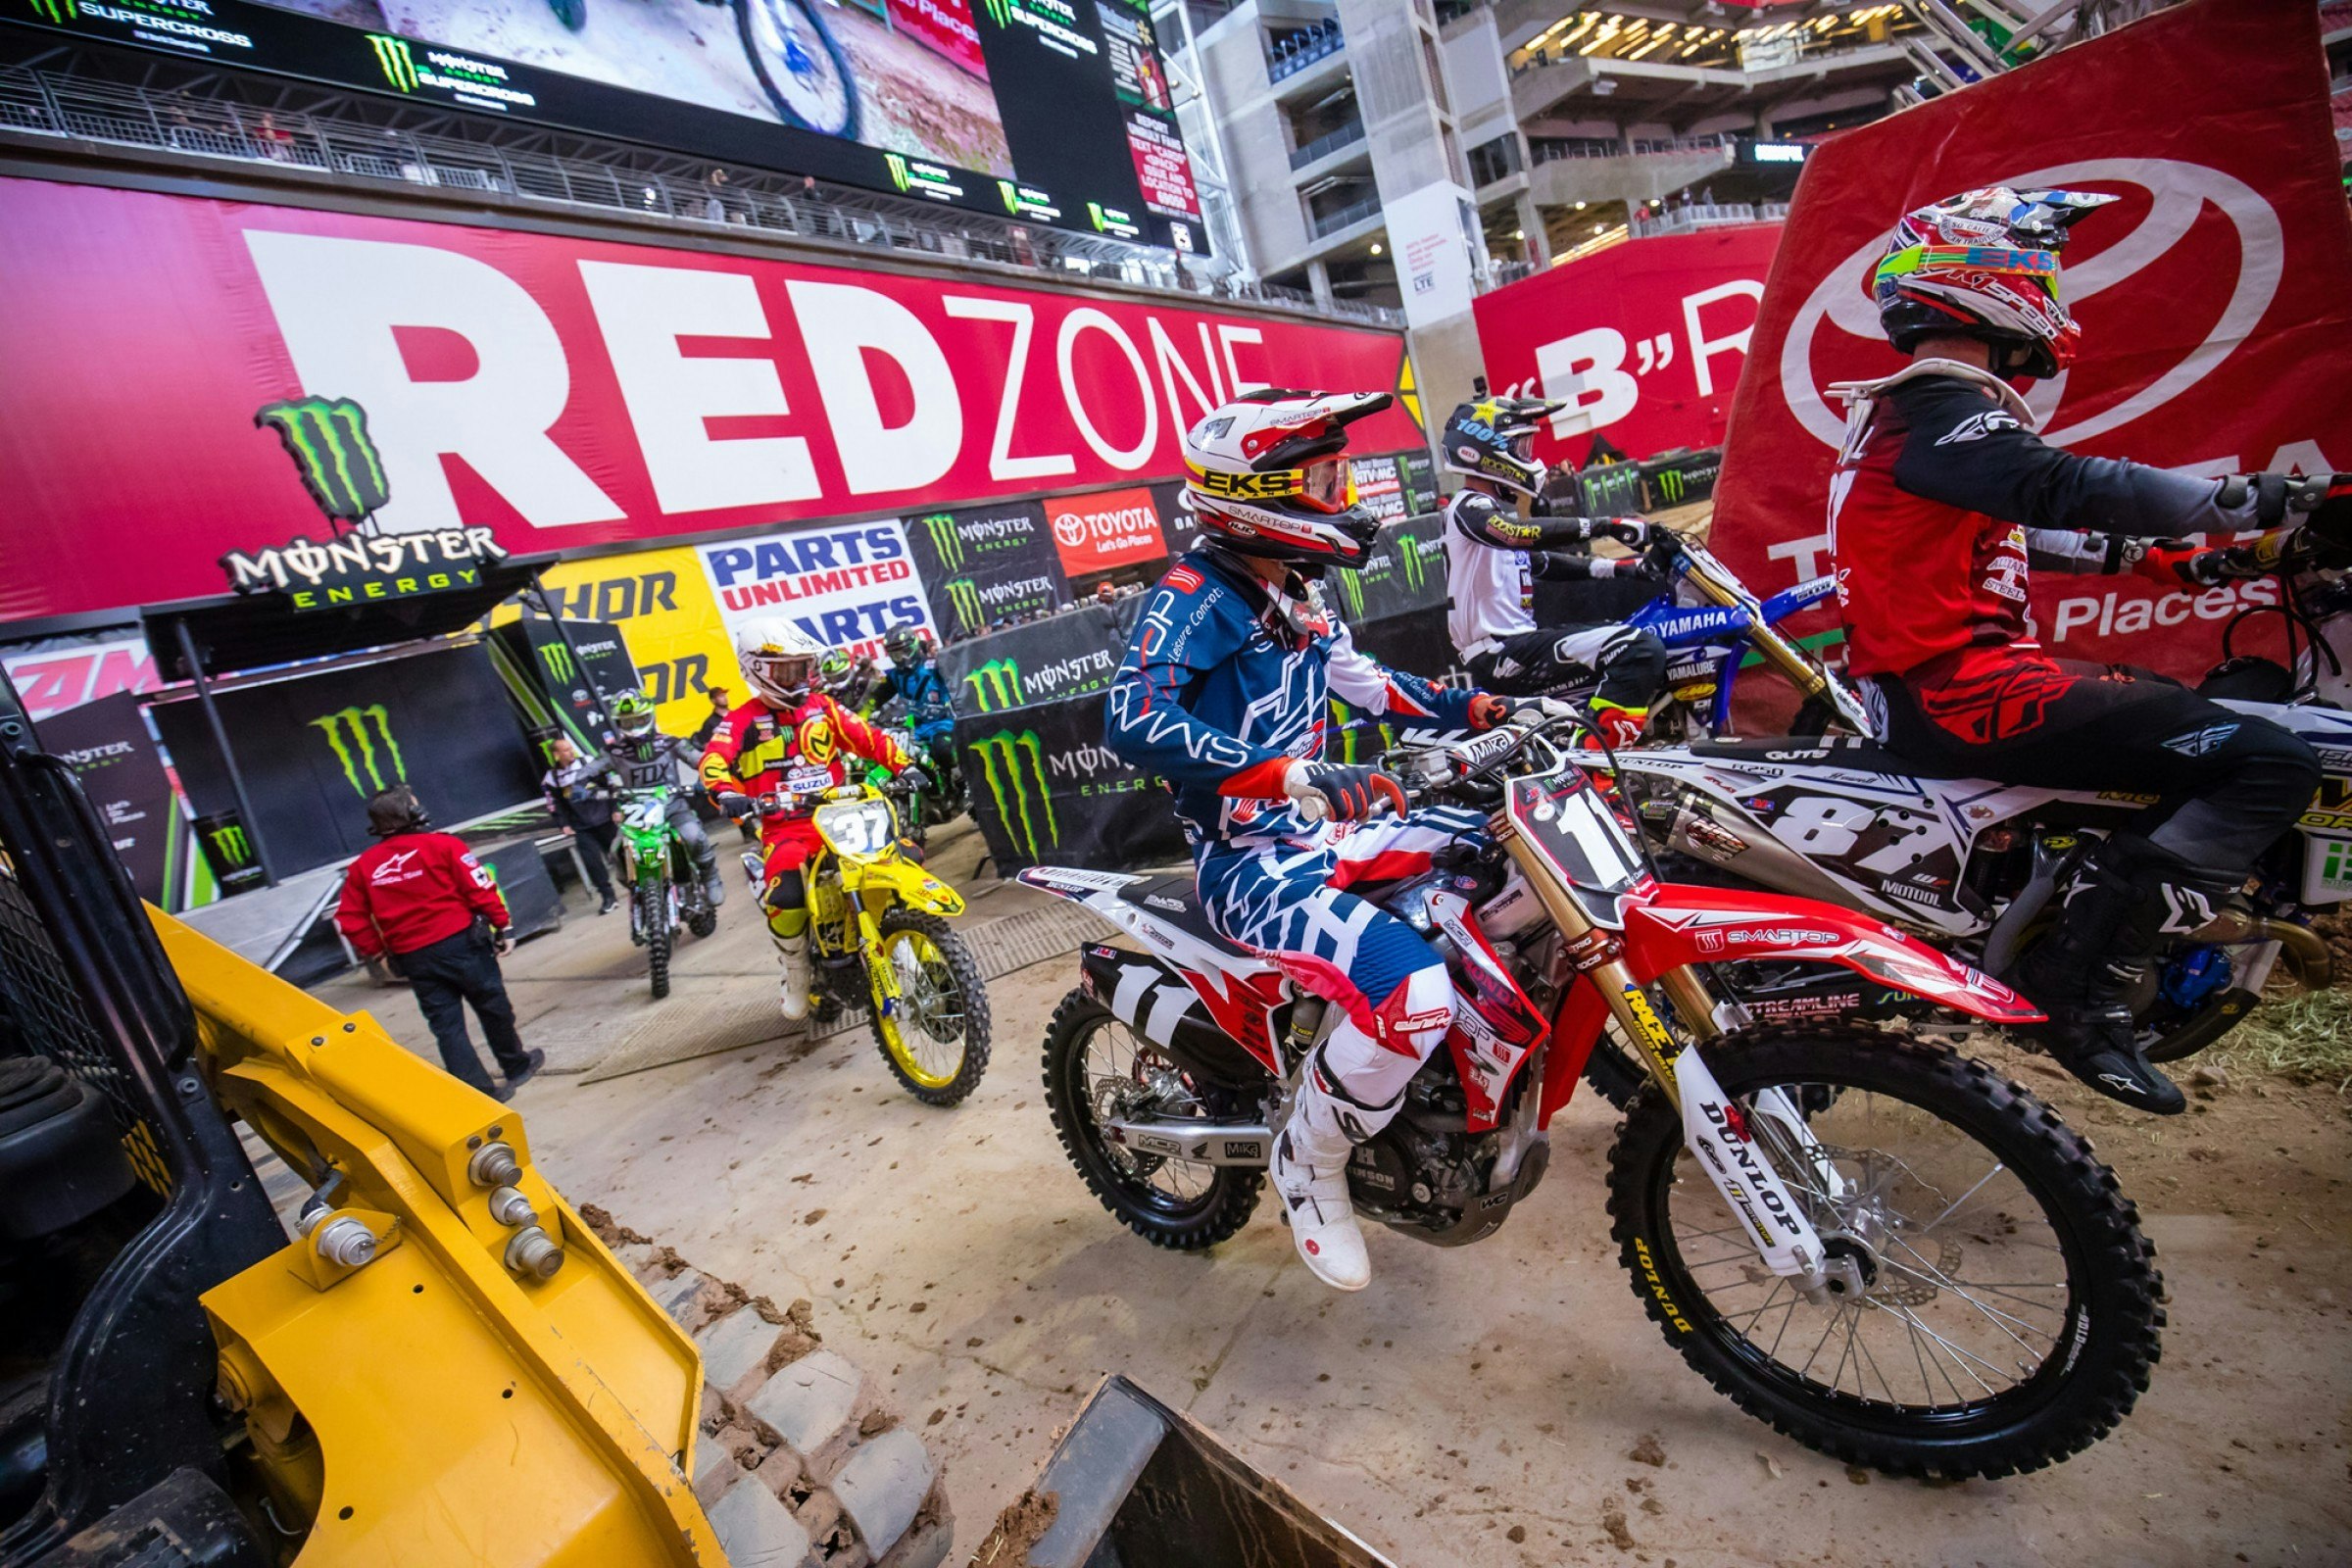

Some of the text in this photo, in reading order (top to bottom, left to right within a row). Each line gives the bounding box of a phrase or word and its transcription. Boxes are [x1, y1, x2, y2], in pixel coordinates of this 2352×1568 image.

[78, 1, 254, 48] SUPERCROSS
[1970, 248, 2056, 272] EKS
[1413, 275, 1435, 292] LTE
[1681, 278, 1767, 398] R
[1270, 410, 1324, 426] SMARTOP
[1456, 417, 1508, 450] 100%
[1203, 470, 1292, 494] EKS
[1683, 466, 1719, 481] MONST
[957, 515, 1035, 542] MONSTER
[1085, 506, 1158, 539] TOYOTA
[1228, 505, 1301, 532] SMARTOP
[1229, 521, 1256, 535] HJC
[706, 526, 904, 588] PARTS
[975, 536, 1029, 553] ENERGY
[1115, 539, 1128, 551] Go
[233, 526, 502, 591] MONSTER
[295, 568, 479, 609] ENERGY
[722, 559, 910, 612] UNLIMITED
[978, 575, 1054, 606] MONSTER
[1984, 579, 2026, 601] STEEL
[996, 596, 1048, 615] ENERGY
[2053, 577, 2278, 643] Places
[792, 595, 926, 648] ARTS
[1658, 611, 1727, 638] YAMAHA
[1168, 623, 1193, 664] Leisure
[1024, 650, 1115, 695] MONSTER
[1667, 660, 1717, 681] YAMALUBE
[1471, 735, 1509, 762] Mika
[1765, 749, 1830, 760] GUTS
[630, 763, 670, 788] FOX
[1081, 775, 1165, 797] ENERG
[833, 808, 890, 857] 37
[1556, 787, 1643, 890] 11
[1770, 796, 1941, 875] 87
[1046, 880, 1085, 893] DUNLOP
[1882, 878, 1942, 908] MOTOOL
[1444, 918, 1474, 949] MCR
[1728, 929, 1839, 946] SMARTOP
[1112, 962, 1200, 1050] 11
[1623, 989, 1676, 1051] RACE
[1138, 1134, 1182, 1155] MCR
[1226, 1143, 1260, 1158] Mika
[1699, 1100, 1802, 1236] DUNLOP
[1481, 1194, 1507, 1210] WC
[1635, 1236, 1693, 1334] DUNLOP
